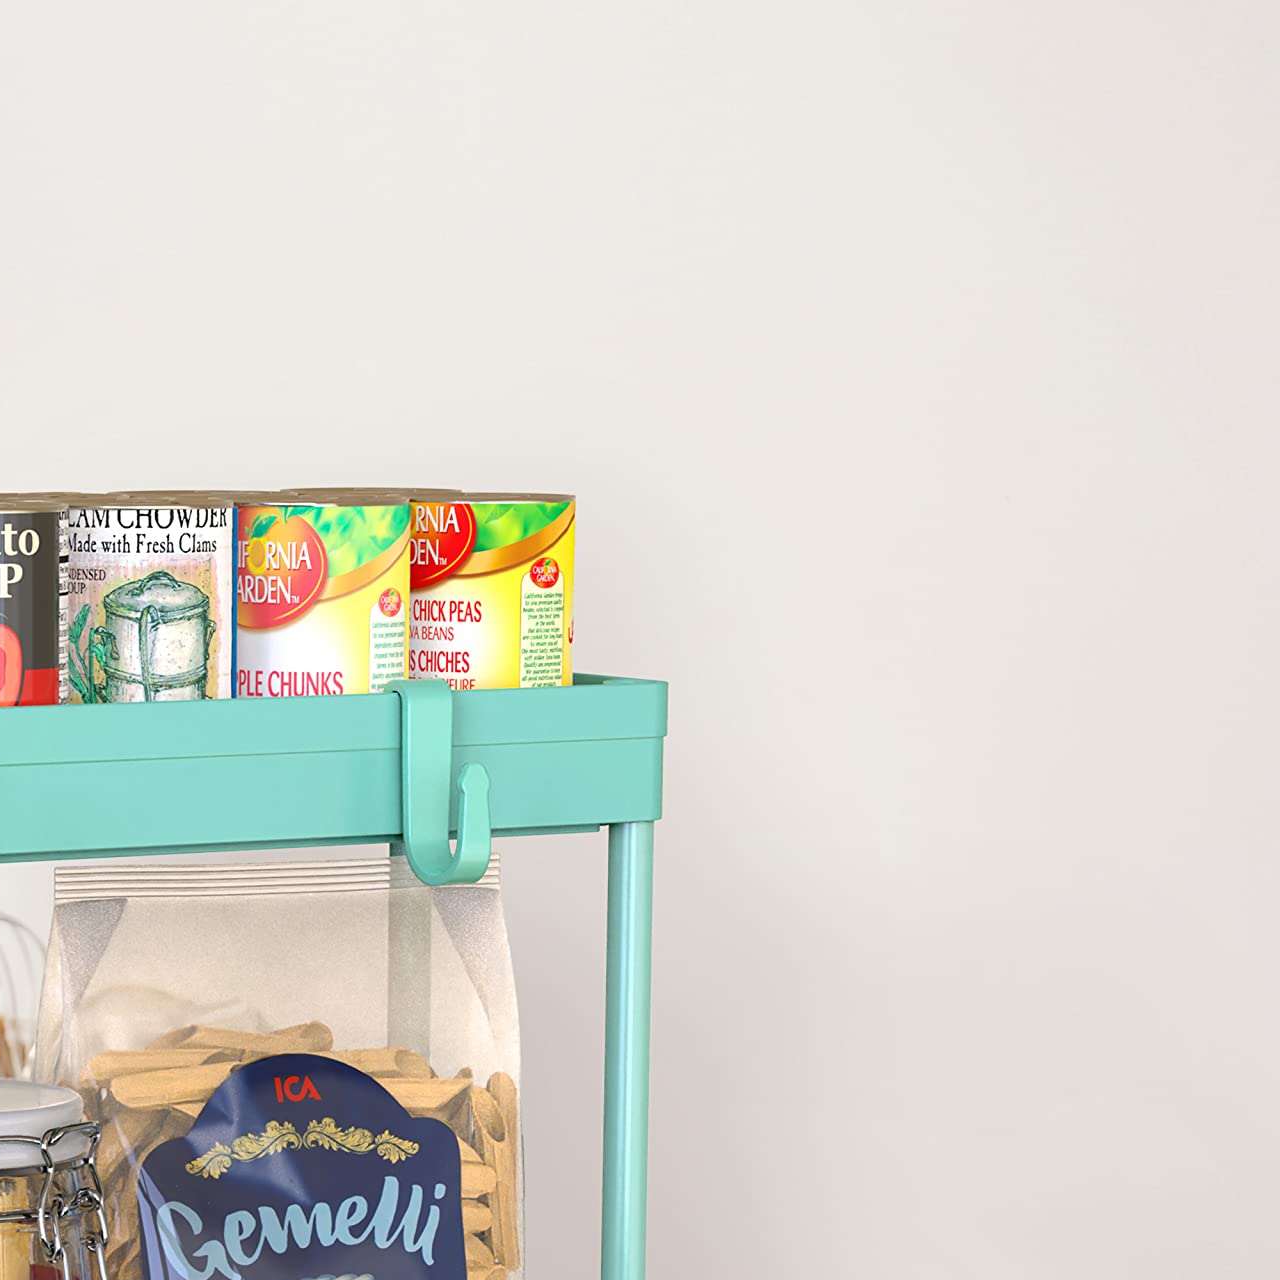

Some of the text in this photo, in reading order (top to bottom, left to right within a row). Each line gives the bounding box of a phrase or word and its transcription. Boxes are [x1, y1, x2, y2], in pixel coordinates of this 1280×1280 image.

[117, 509, 228, 529] CHOWDER
[101, 534, 131, 553] with
[136, 533, 174, 553] Fresh
[179, 532, 217, 553] Clams
[413, 599, 446, 622] CHICK
[449, 600, 482, 623] PEAS
[421, 626, 455, 641] BEANS
[418, 650, 470, 673] CHICHES
[236, 669, 344, 697] PLE CHUNKS
[274, 1075, 322, 1103] ICA
